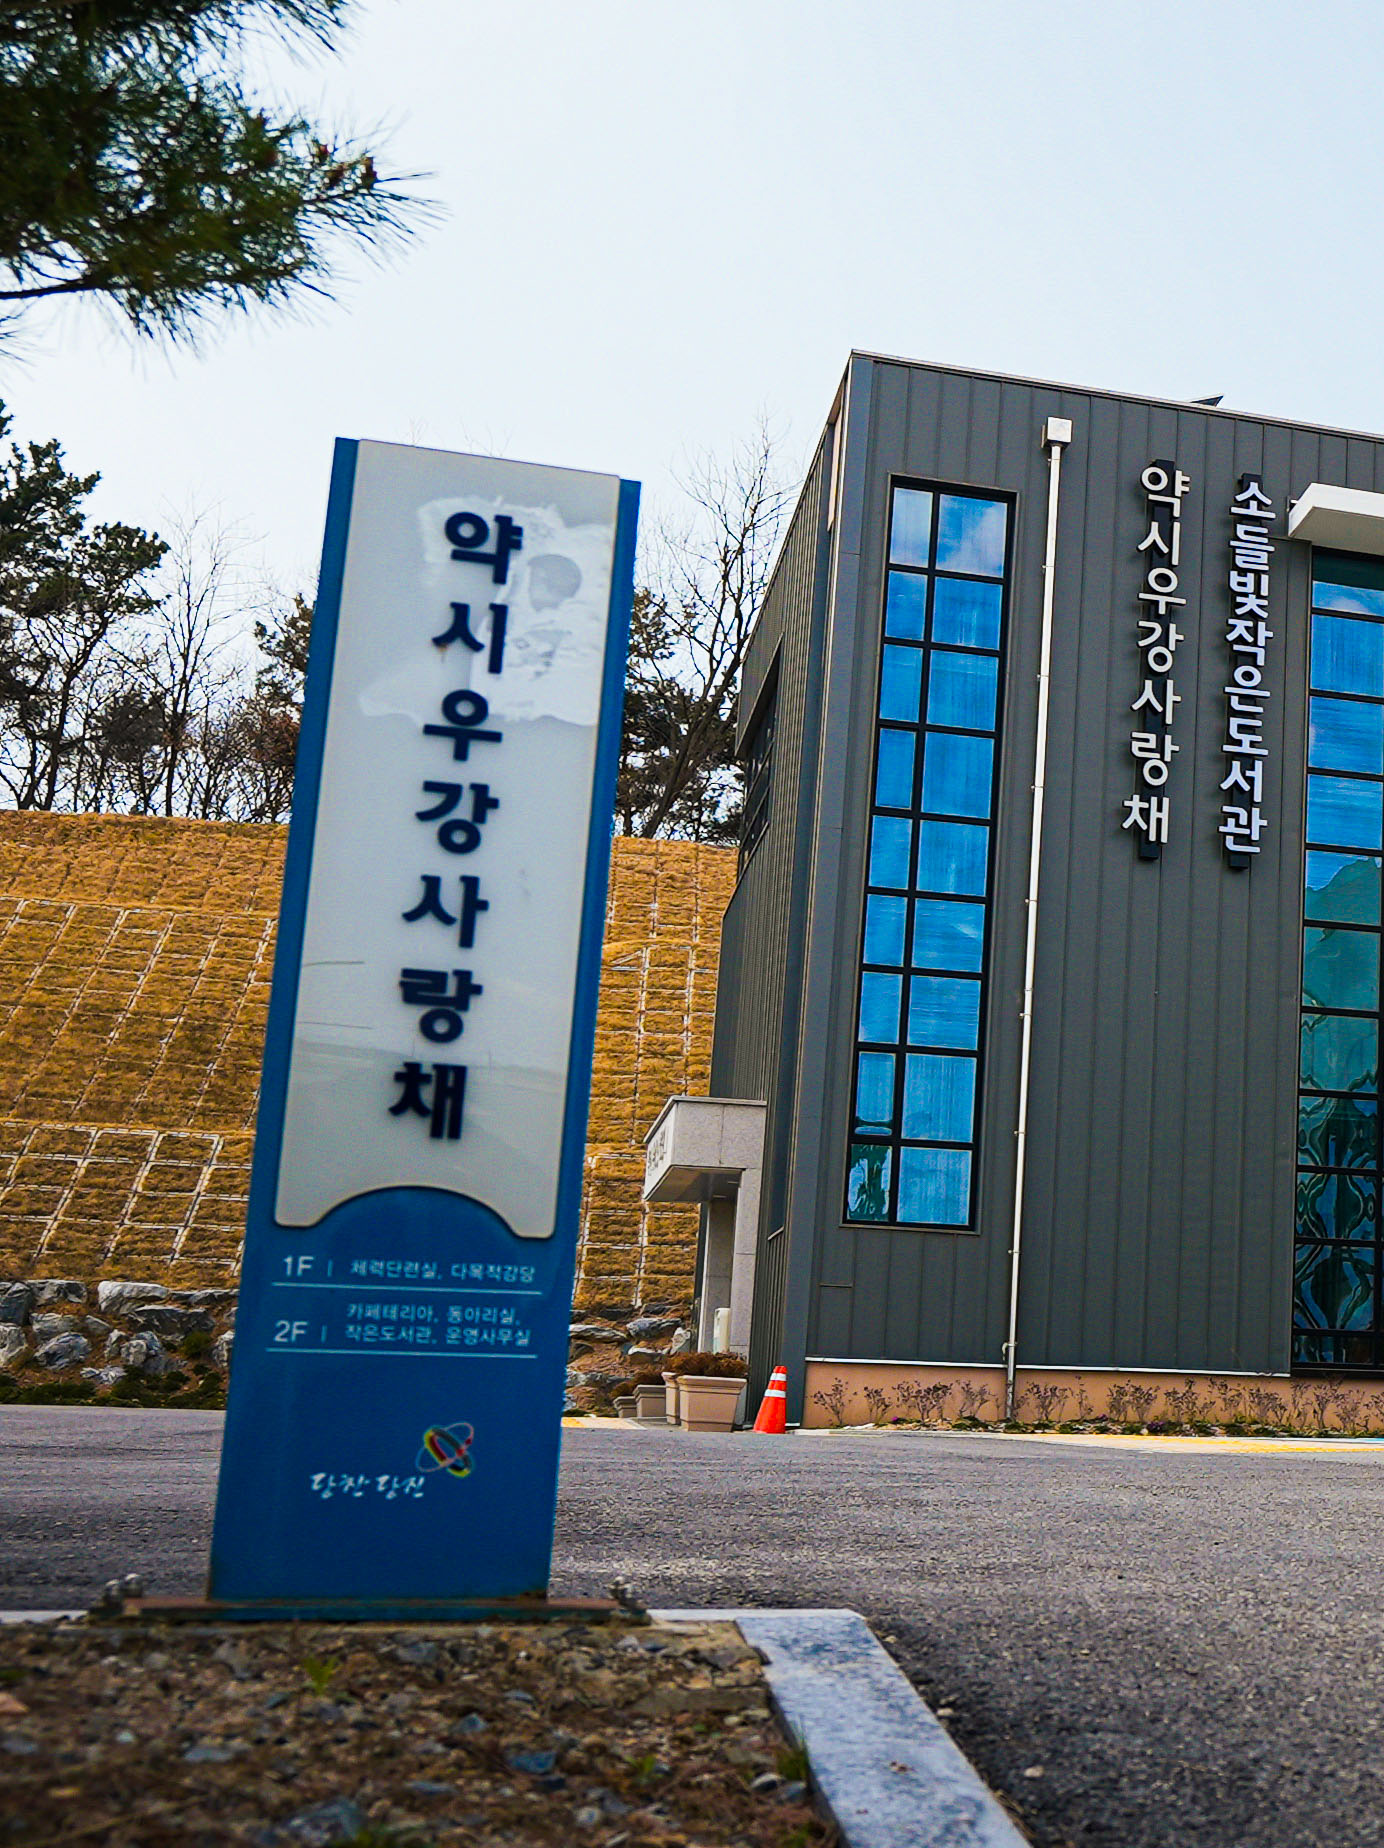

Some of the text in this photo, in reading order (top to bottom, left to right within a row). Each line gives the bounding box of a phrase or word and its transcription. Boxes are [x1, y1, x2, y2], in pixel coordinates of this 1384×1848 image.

[388, 511, 524, 1140] 약시우강사랑채
[1121, 466, 1190, 844] 약시우강사랑채
[1218, 481, 1276, 854] 소들빛작은도서관
[274, 1319, 309, 1343] 2F
[283, 1255, 315, 1277] 1F
